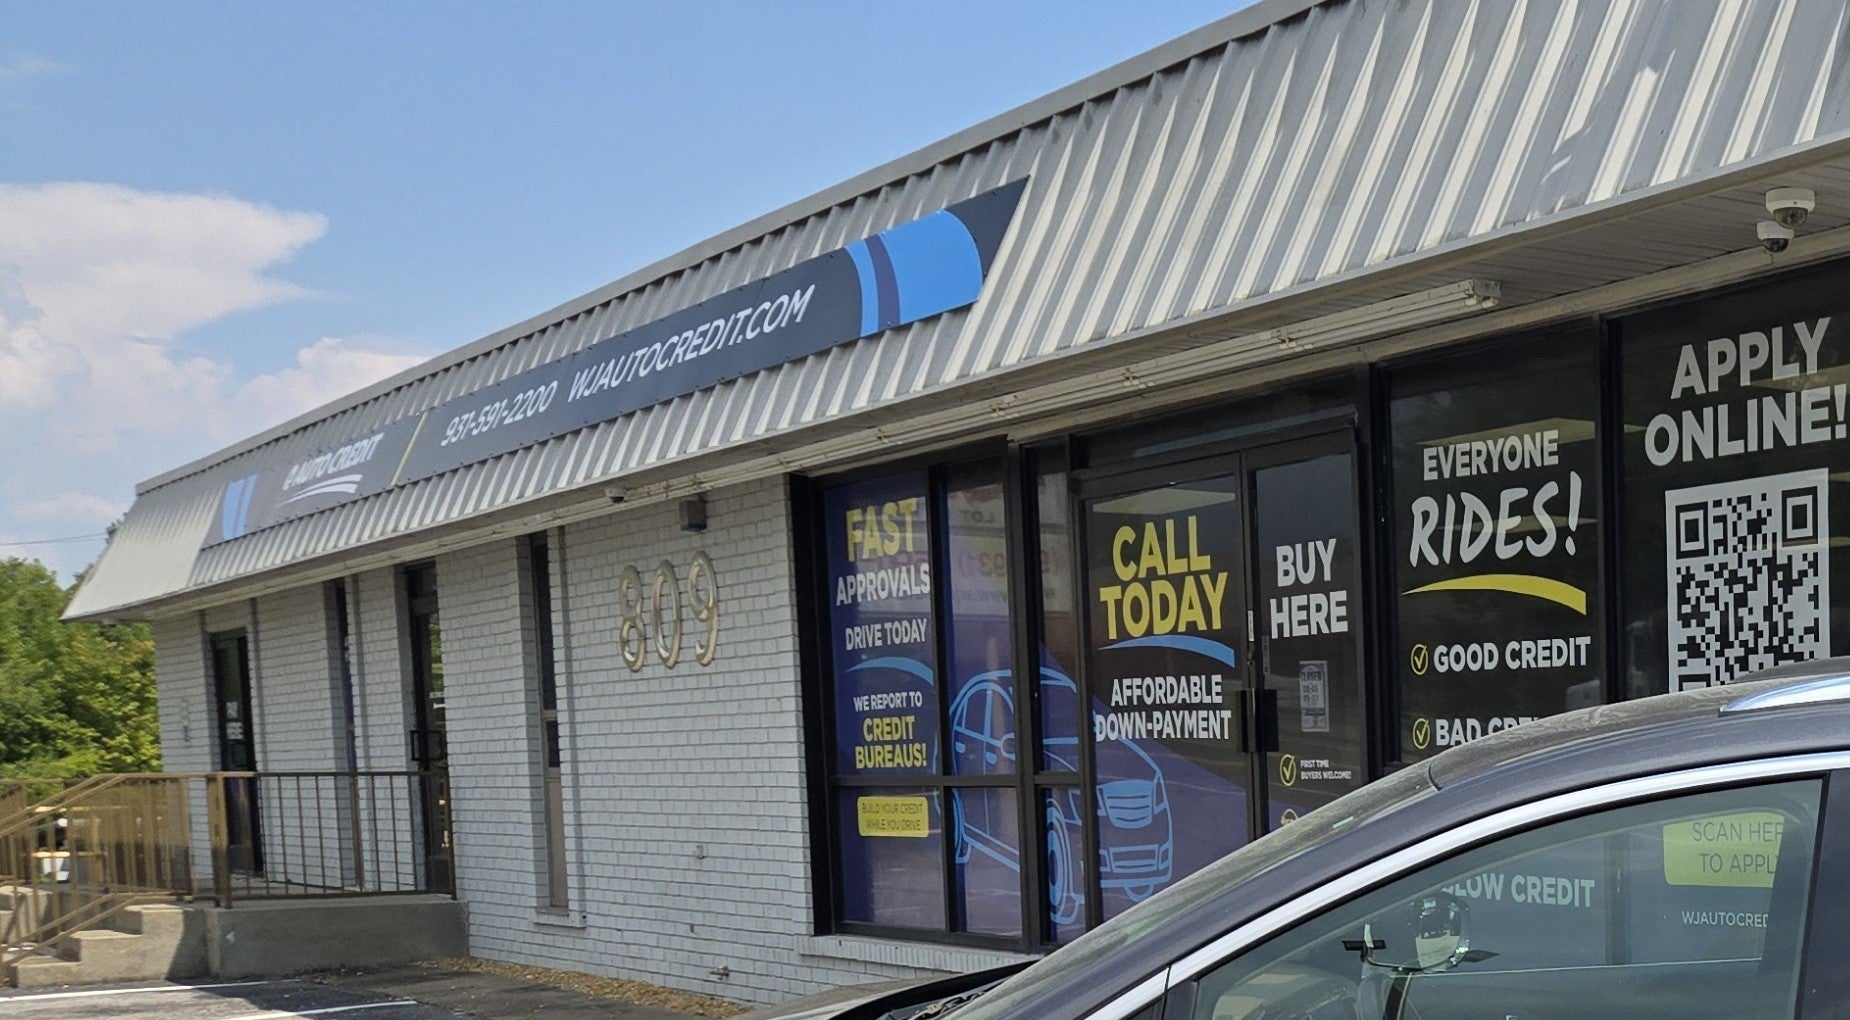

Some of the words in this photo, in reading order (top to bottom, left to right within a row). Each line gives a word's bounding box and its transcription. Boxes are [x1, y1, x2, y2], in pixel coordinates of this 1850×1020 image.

[440, 380, 558, 446] 931-591-2200
[567, 284, 815, 403] WJAUTOCREDIT.COM
[1670, 317, 1832, 400] APPLY
[1644, 383, 1847, 467] ONLINE!
[1423, 429, 1559, 481] EVERYONE
[846, 498, 917, 561] FAST
[1409, 471, 1582, 568] RIDES!
[1112, 515, 1211, 581] CALL
[1275, 538, 1337, 587] BUY
[836, 563, 930, 606] APPROVALS
[1099, 572, 1228, 640] TODAY
[619, 550, 719, 673] 809
[1270, 590, 1348, 639] HERE
[845, 621, 883, 651] DRIVE
[884, 618, 927, 644] TODAY
[1433, 642, 1499, 673] GOOD
[1505, 636, 1591, 670] CREDIT
[853, 696, 870, 712] WE
[870, 693, 908, 710] REPORT
[908, 691, 923, 707] TO
[1111, 674, 1223, 707] AFFORDABLE
[863, 715, 915, 742] CREDIT
[1095, 710, 1231, 742] DOWN-PAYMENT
[1435, 717, 1481, 746] BAD
[855, 742, 927, 769] BUREAUS!
[1692, 822, 1742, 842] SCAN
[1700, 853, 1723, 873] TO
[1730, 853, 1779, 874] APPL
[1510, 875, 1595, 908] CREDIT
